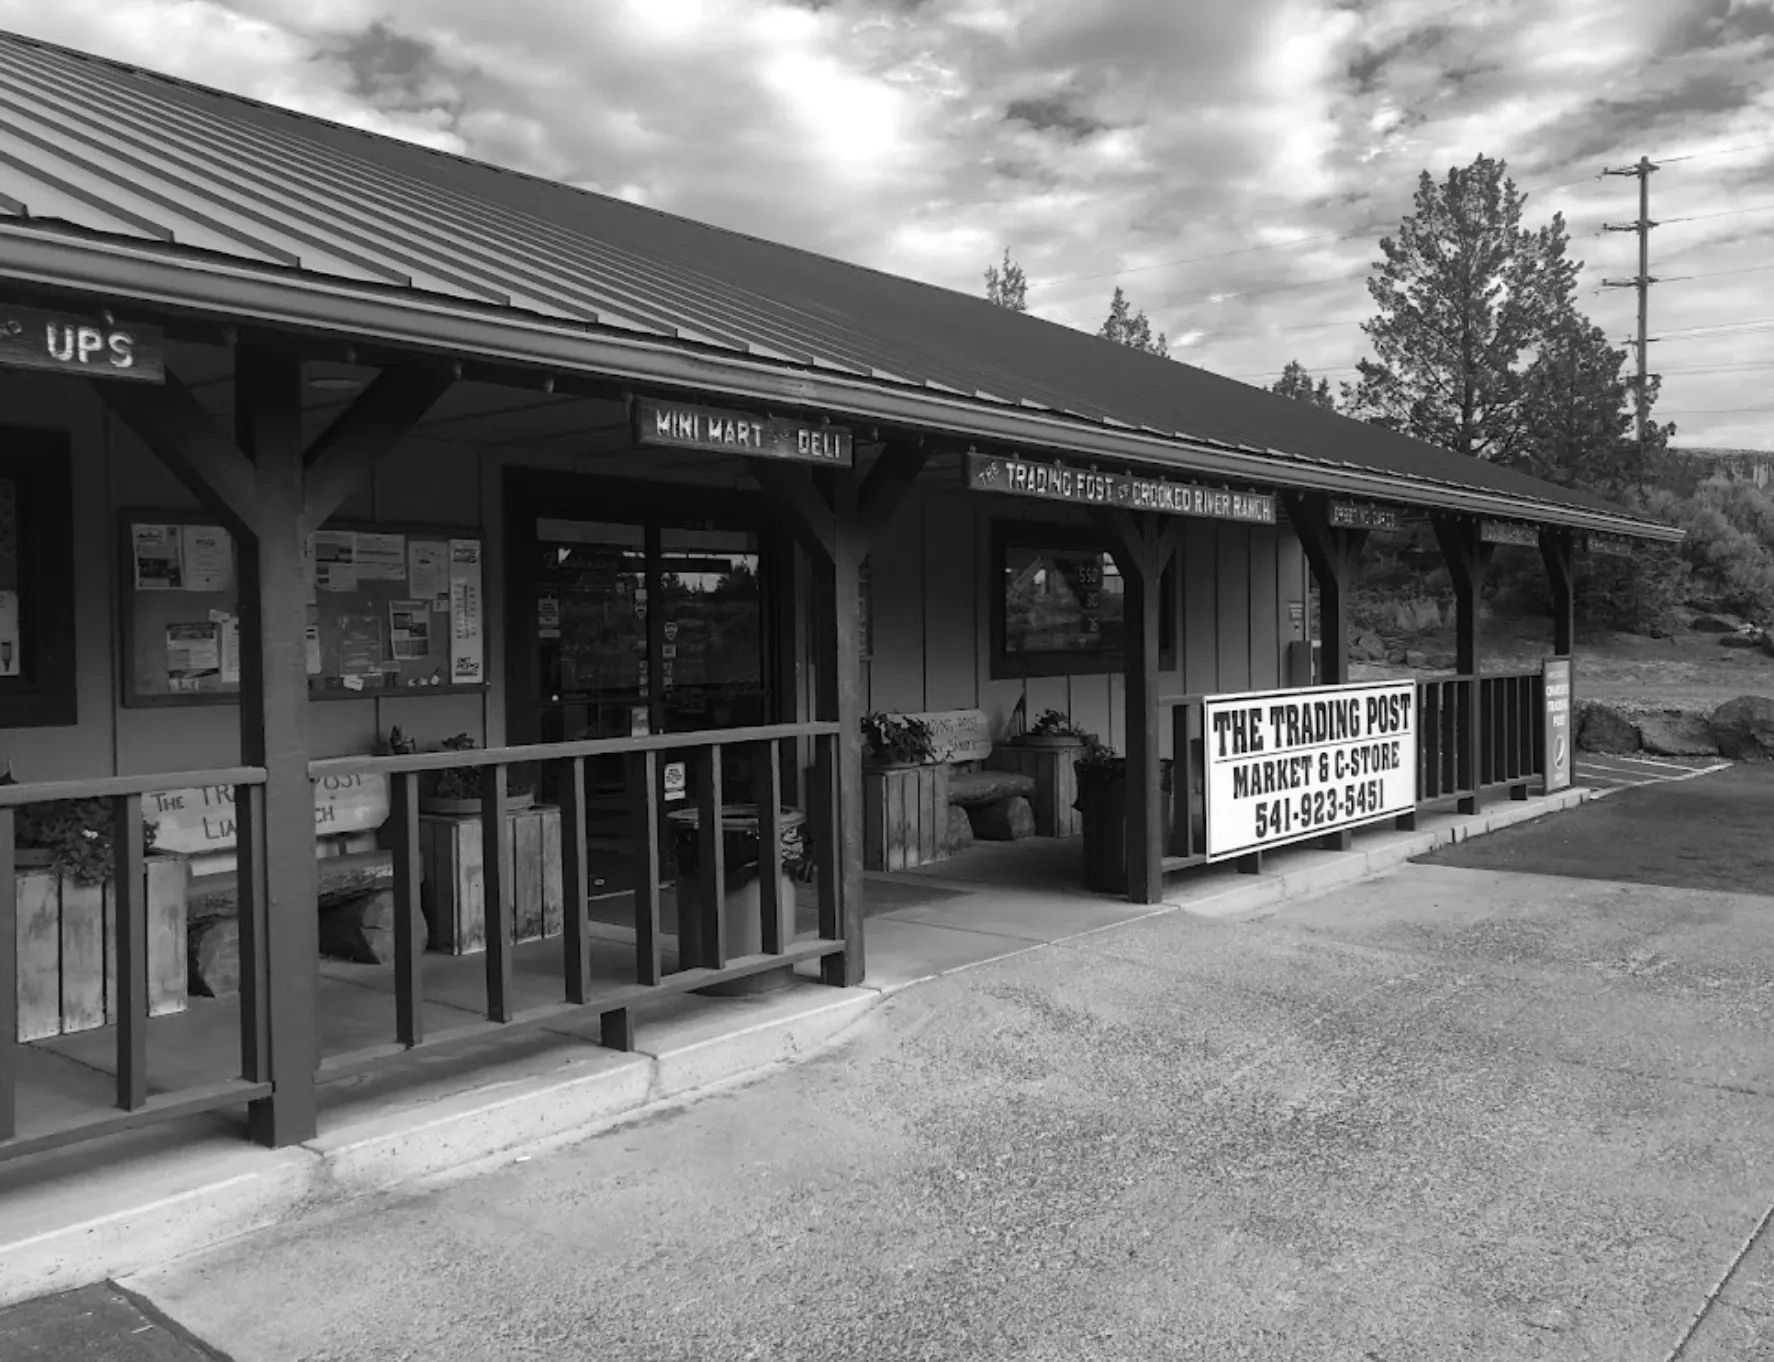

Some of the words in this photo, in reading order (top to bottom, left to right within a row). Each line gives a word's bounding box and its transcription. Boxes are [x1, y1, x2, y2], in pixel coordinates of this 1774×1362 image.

[46, 322, 134, 368] UPS
[656, 408, 699, 441] MINI
[708, 415, 762, 448] MART
[797, 428, 840, 458] DELI
[1005, 461, 1071, 497] TRADING
[1076, 472, 1114, 502] POST
[1132, 481, 1191, 512] CROOKED
[1194, 489, 1229, 516] RIVER
[1232, 494, 1272, 521] RANCH
[1213, 707, 1264, 757] THE
[1270, 697, 1360, 748] TRADING
[1366, 693, 1411, 735] POST
[1232, 754, 1313, 799] MARKET
[1319, 751, 1329, 783] &
[1335, 741, 1400, 780] C-STORE
[1255, 778, 1384, 838] 541-923-5451
